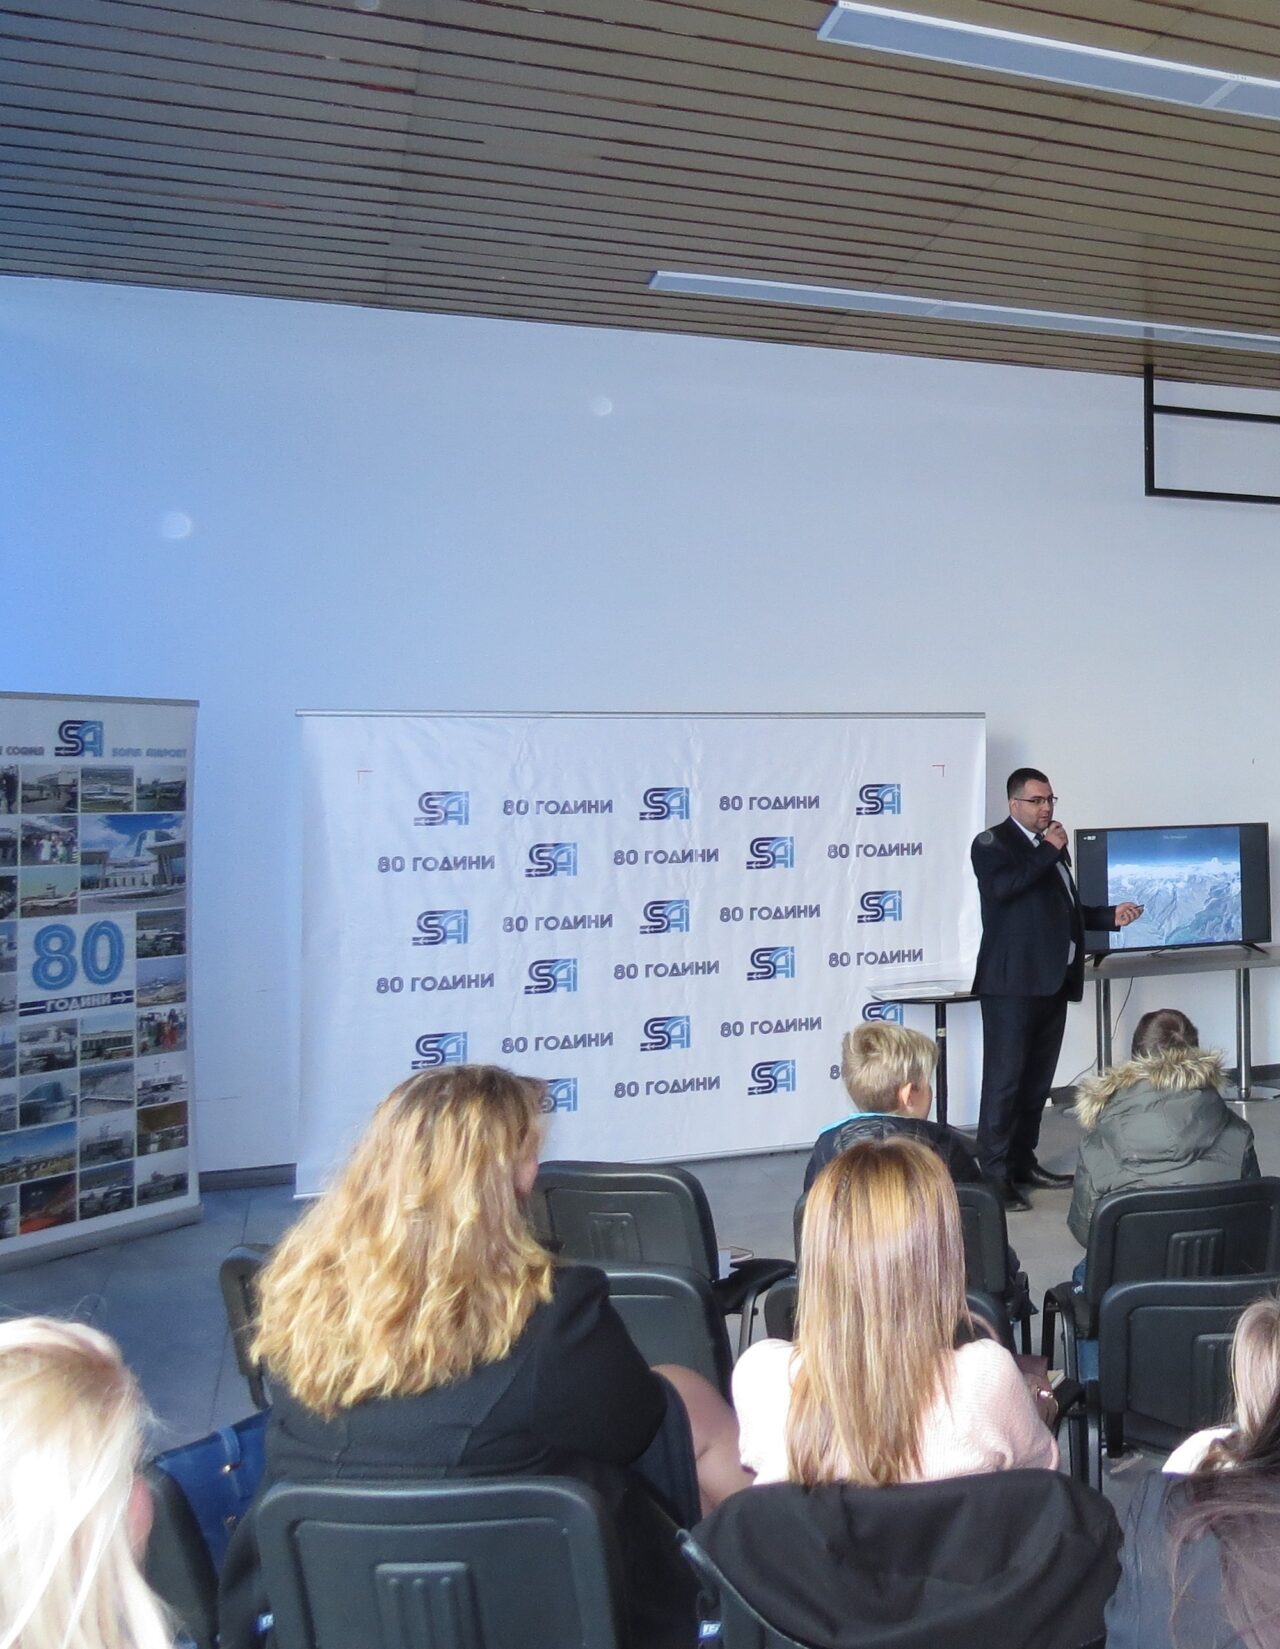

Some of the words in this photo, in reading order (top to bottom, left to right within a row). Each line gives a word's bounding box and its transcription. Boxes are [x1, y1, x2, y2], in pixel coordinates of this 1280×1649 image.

[503, 799, 529, 816] 80
[535, 799, 613, 815] ГОДИНИ
[719, 795, 743, 811] 80
[749, 795, 820, 811] ГОДИНИ
[613, 850, 638, 865] 80
[644, 848, 719, 864] ГОДИНИ
[827, 844, 850, 859] 80
[855, 842, 923, 858] ГОДИНИ
[377, 856, 405, 873] 80
[412, 855, 495, 872] ГОДИНИ
[502, 916, 528, 933] 80
[535, 913, 613, 931] ГОДИНИ
[719, 907, 744, 922] 80
[749, 904, 821, 921] ГОДИНИ
[32, 920, 125, 991] 80
[828, 952, 851, 968] 80
[856, 948, 924, 965] ГОДИНИ
[613, 964, 638, 980] 80
[645, 960, 720, 978] ГОДИНИ
[376, 977, 404, 994] 80
[411, 973, 494, 992] ГОДИНИ
[46, 993, 112, 1012] ГОДИНИ
[720, 1021, 744, 1037] 80
[750, 1017, 822, 1036] ГОДИНИ
[501, 1037, 528, 1054] 80
[535, 1032, 614, 1051] ГОДИНИ
[614, 1082, 640, 1098] 80
[645, 1076, 721, 1096] ГОДИНИ
